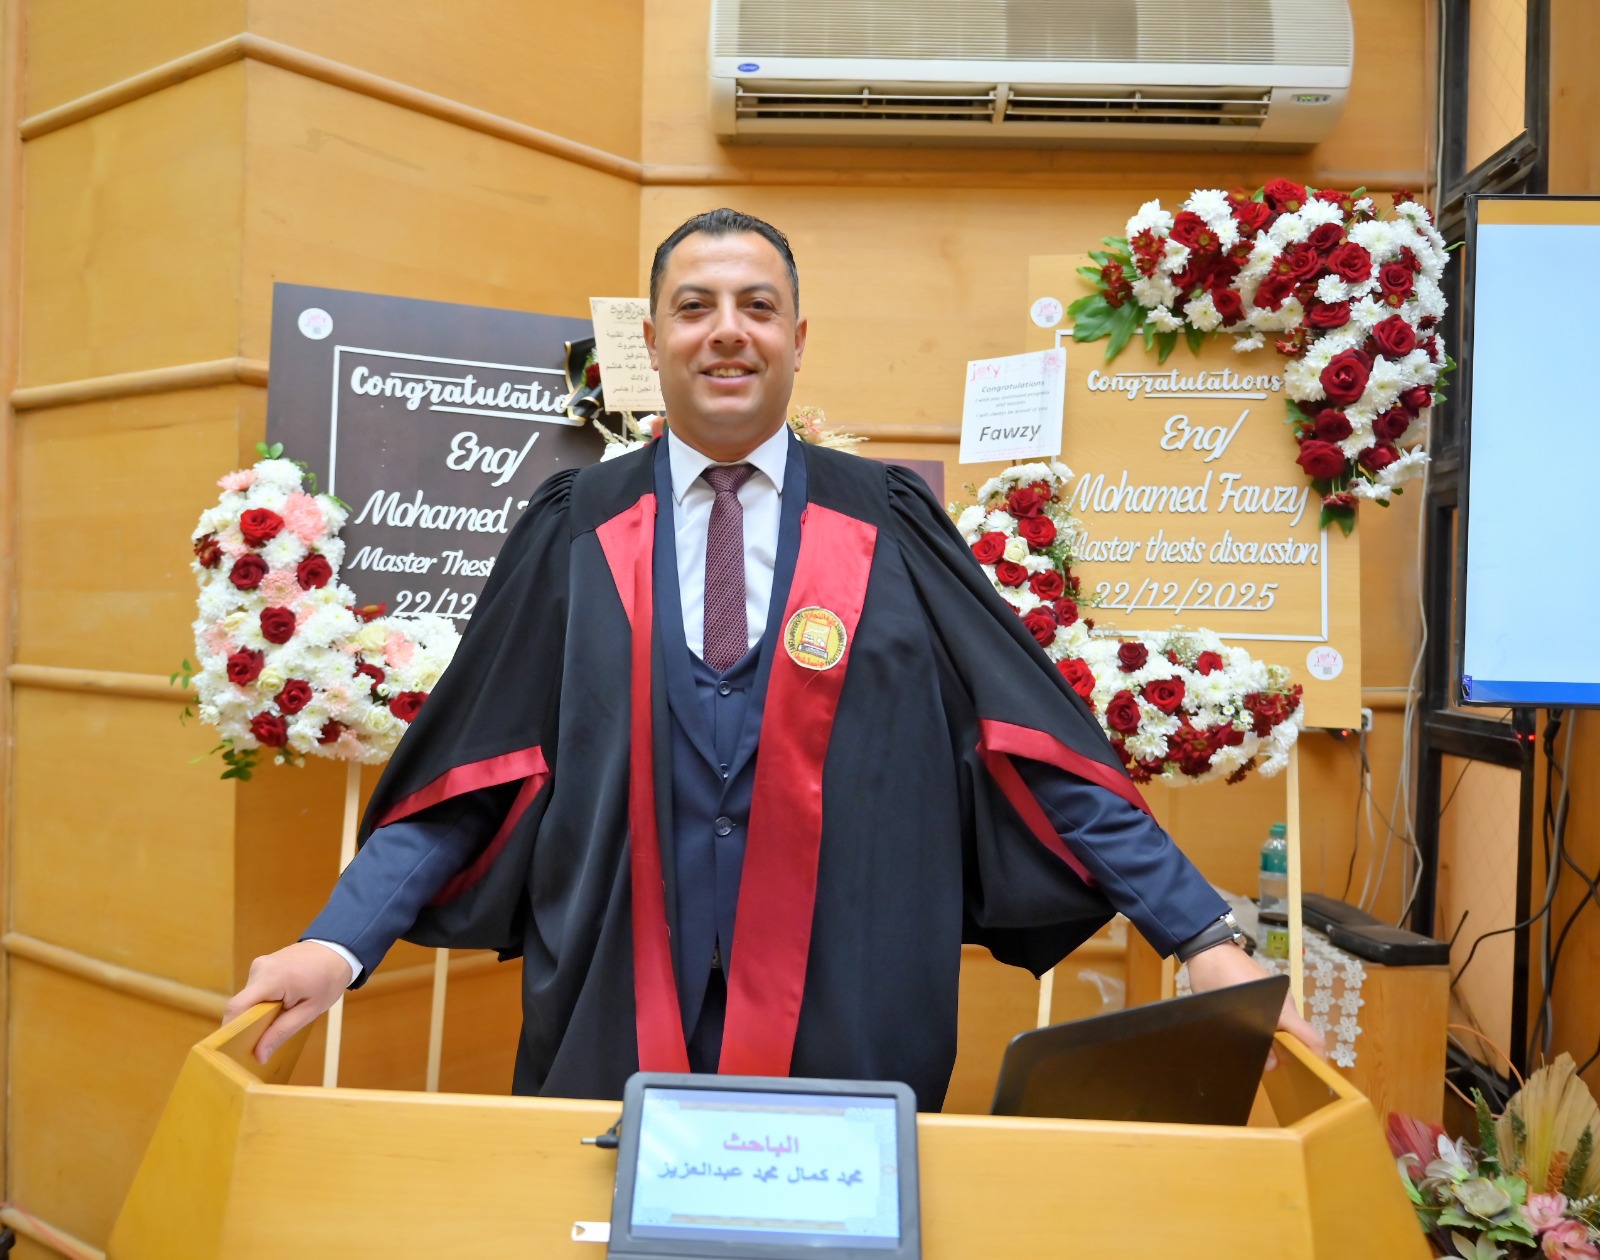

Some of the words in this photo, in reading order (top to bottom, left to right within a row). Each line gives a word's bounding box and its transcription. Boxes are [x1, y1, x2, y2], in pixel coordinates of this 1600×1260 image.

[351, 366, 567, 413] Congratulatio
[981, 379, 1045, 394] Congratulations
[1087, 368, 1284, 400] Congratulations
[979, 424, 1042, 442] Fawzy
[1160, 408, 1250, 463] Eng/
[446, 431, 540, 488] Eng/
[354, 489, 513, 534] Mohamed
[1065, 469, 1213, 513] Mohamed
[1218, 472, 1310, 527] Fawzy
[347, 545, 438, 574] Master
[441, 549, 496, 577] Thesi
[1145, 529, 1207, 563] thesis
[1209, 529, 1319, 565] discussion
[392, 587, 477, 620] 22/12
[1091, 577, 1279, 615] 22/12/2025
[723, 1132, 799, 1158] الباحث
[752, 1165, 779, 1183] محمد
[787, 1166, 829, 1184] كمال
[837, 1169, 863, 1187] محمد
